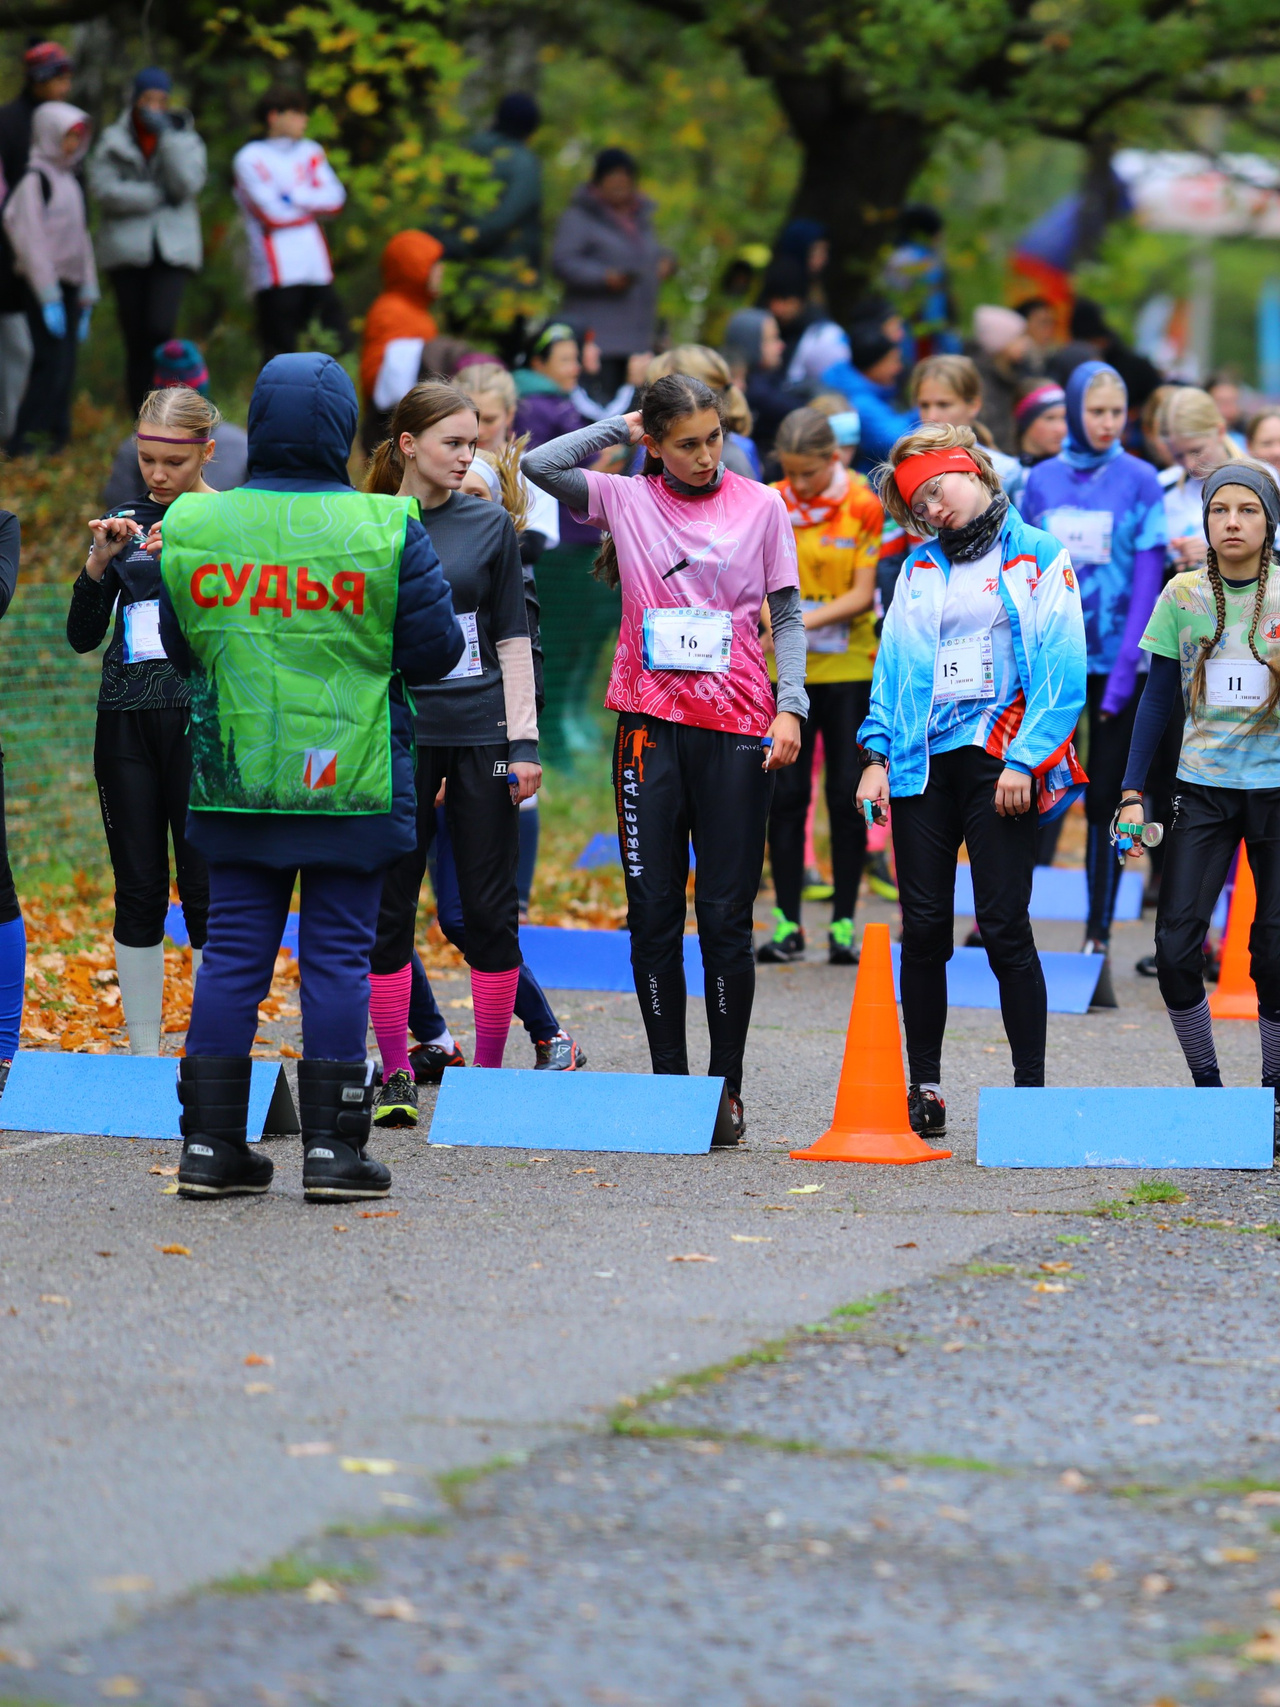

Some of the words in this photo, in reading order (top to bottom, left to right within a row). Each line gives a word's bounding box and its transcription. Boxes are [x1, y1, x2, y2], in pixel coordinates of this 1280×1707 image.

[190, 562, 366, 618] СУДЬЯ
[679, 634, 698, 649] 16
[943, 661, 958, 678] 15
[1227, 676, 1242, 691] 11
[623, 769, 644, 878] НАВСЕГДА
